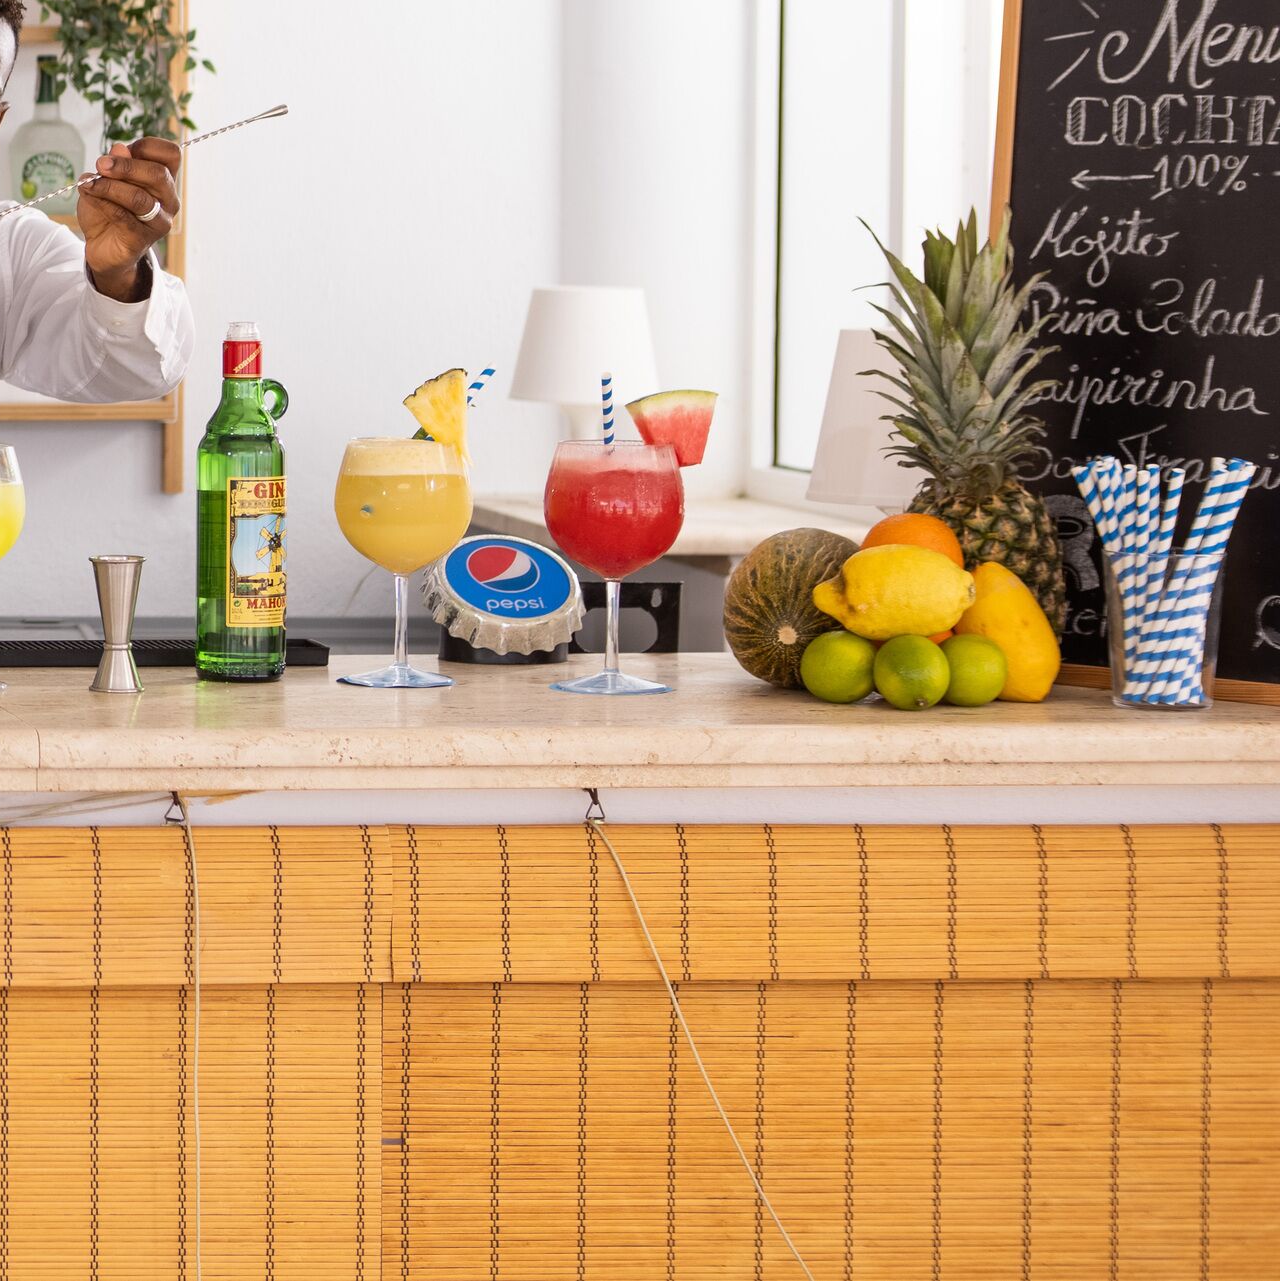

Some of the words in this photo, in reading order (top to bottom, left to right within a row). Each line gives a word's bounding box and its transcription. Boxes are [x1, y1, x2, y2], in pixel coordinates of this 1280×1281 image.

[1150, 154, 1250, 200] 100%
[1029, 205, 1180, 288] Mojito
[1026, 281, 1130, 338] Piña
[486, 596, 545, 612] pepsi
